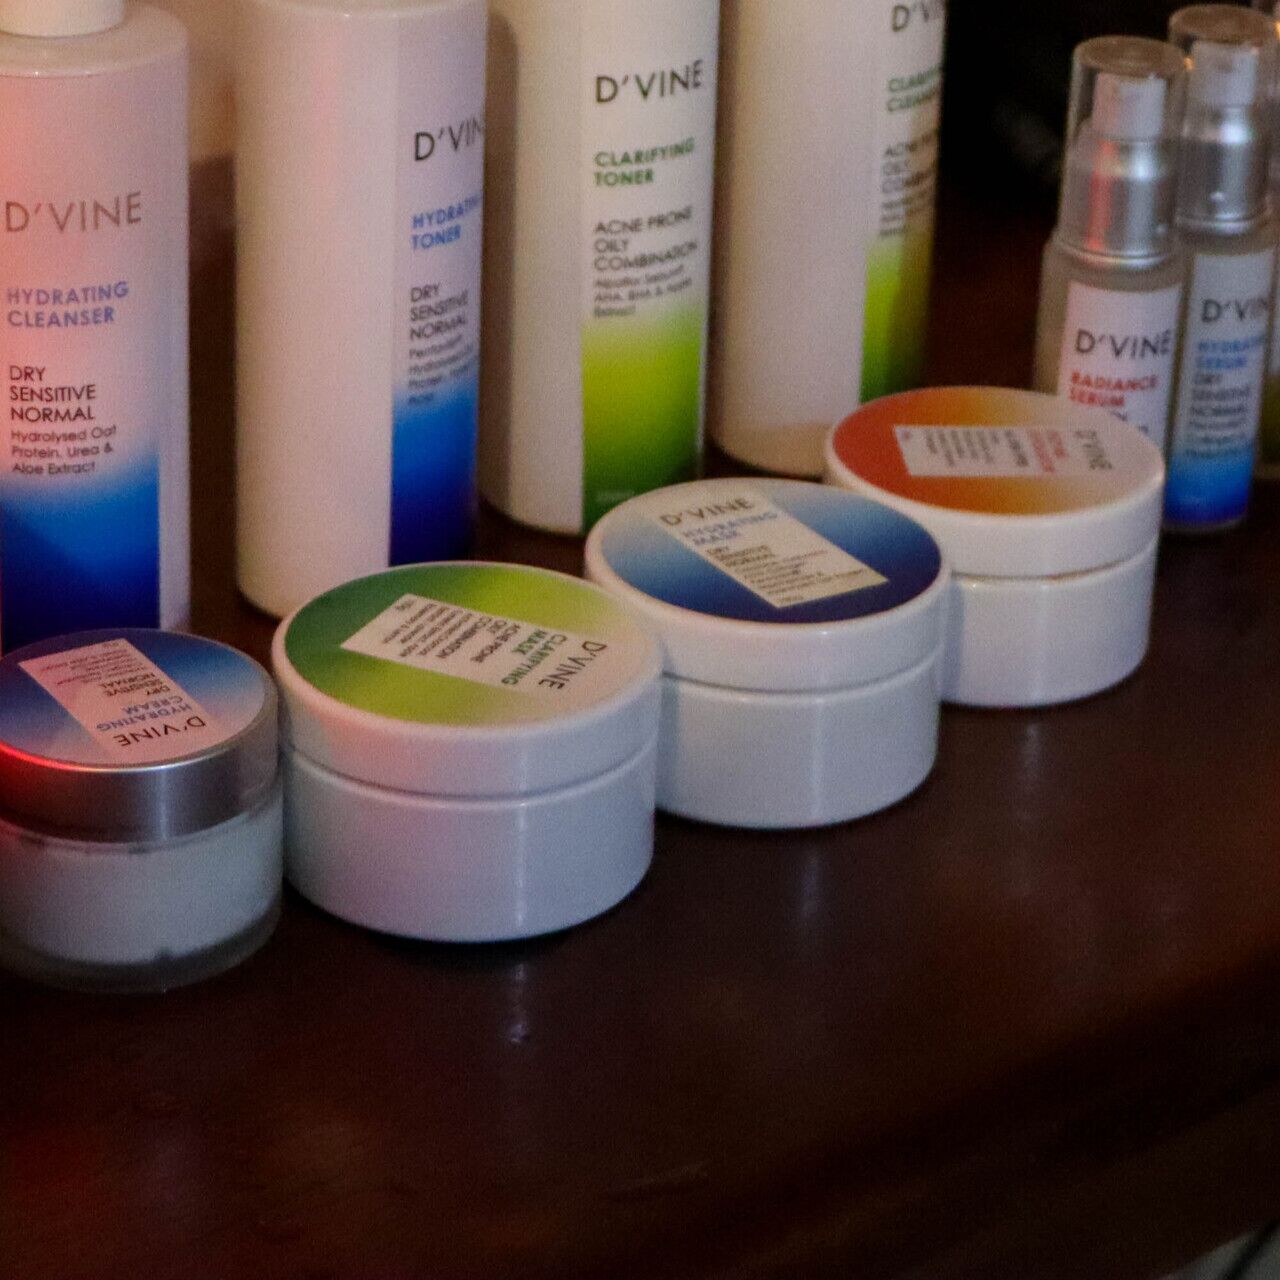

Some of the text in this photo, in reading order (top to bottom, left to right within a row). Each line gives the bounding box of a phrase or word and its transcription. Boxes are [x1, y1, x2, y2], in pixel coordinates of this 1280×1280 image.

[595, 59, 702, 104] D'VINE
[594, 136, 695, 168] CLARIFYING
[594, 169, 654, 187] TONER
[5, 192, 142, 233] D'VINE
[594, 217, 643, 234] ACNE
[411, 225, 462, 250] TONER
[594, 238, 629, 254] OILY
[7, 281, 130, 306] HYDRATING
[411, 283, 440, 302] DRY
[7, 306, 116, 328] CLEANSER
[1075, 328, 1172, 358] D'VINE
[10, 365, 46, 381] DRY
[1071, 371, 1158, 392] RADIANCE
[10, 384, 96, 402] SENSITIVE
[10, 405, 96, 422] NORMAL
[11, 424, 117, 444] Hydrolysed Oat
[68, 443, 101, 458] Urea
[660, 498, 755, 526] D'VINE
[501, 633, 568, 686] CLARIFYING
[538, 640, 608, 690] D'VINE
[123, 695, 184, 714] CREAM
[96, 703, 193, 732] HYDRATING
[113, 715, 206, 747] D'VINE
